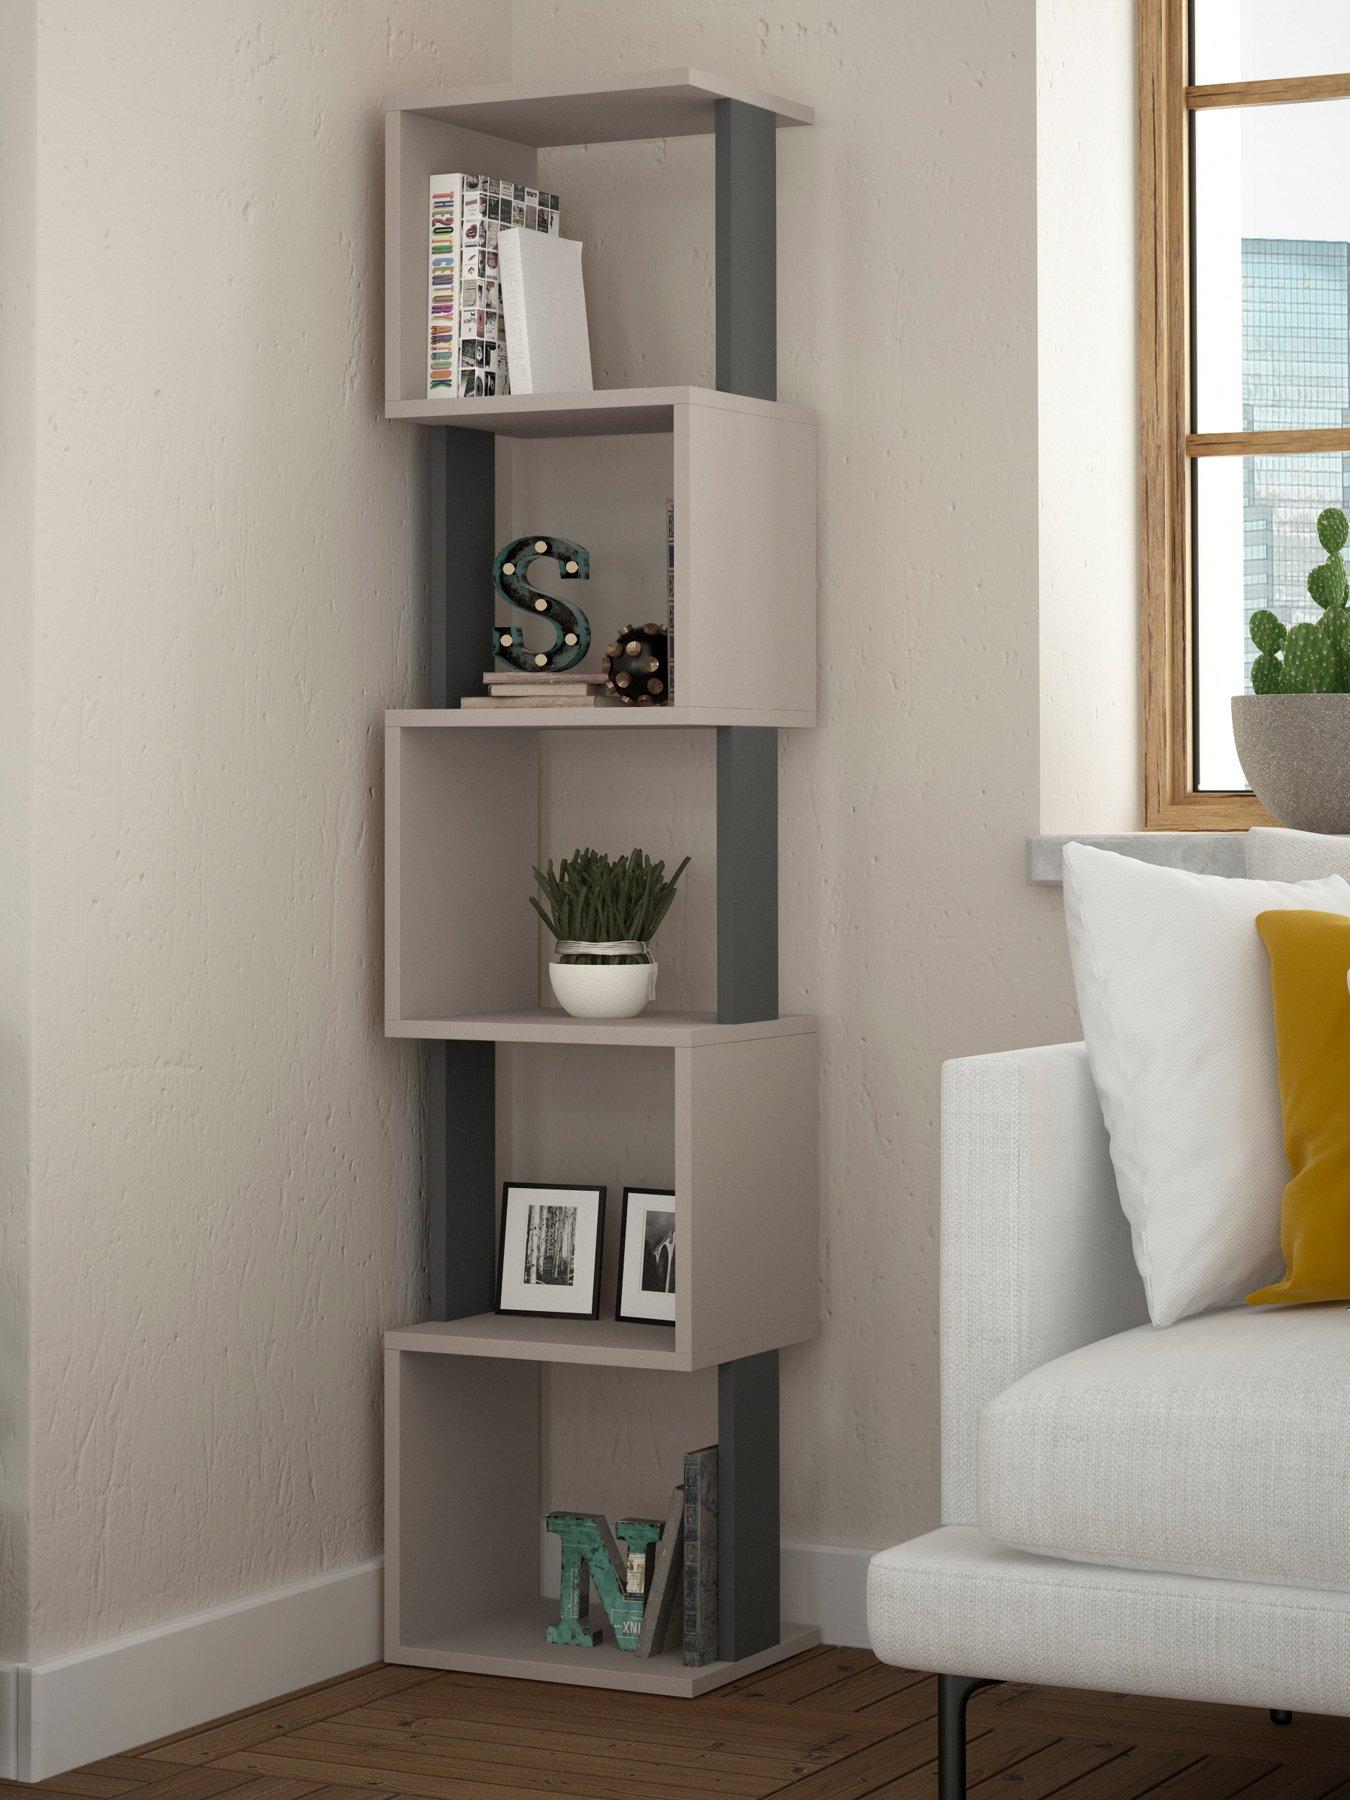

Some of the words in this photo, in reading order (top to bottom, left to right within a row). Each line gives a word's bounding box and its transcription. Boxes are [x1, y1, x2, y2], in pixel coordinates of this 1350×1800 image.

[431, 257, 454, 320] CENTURY
[492, 535, 591, 672] S
[546, 1511, 664, 1652] N
